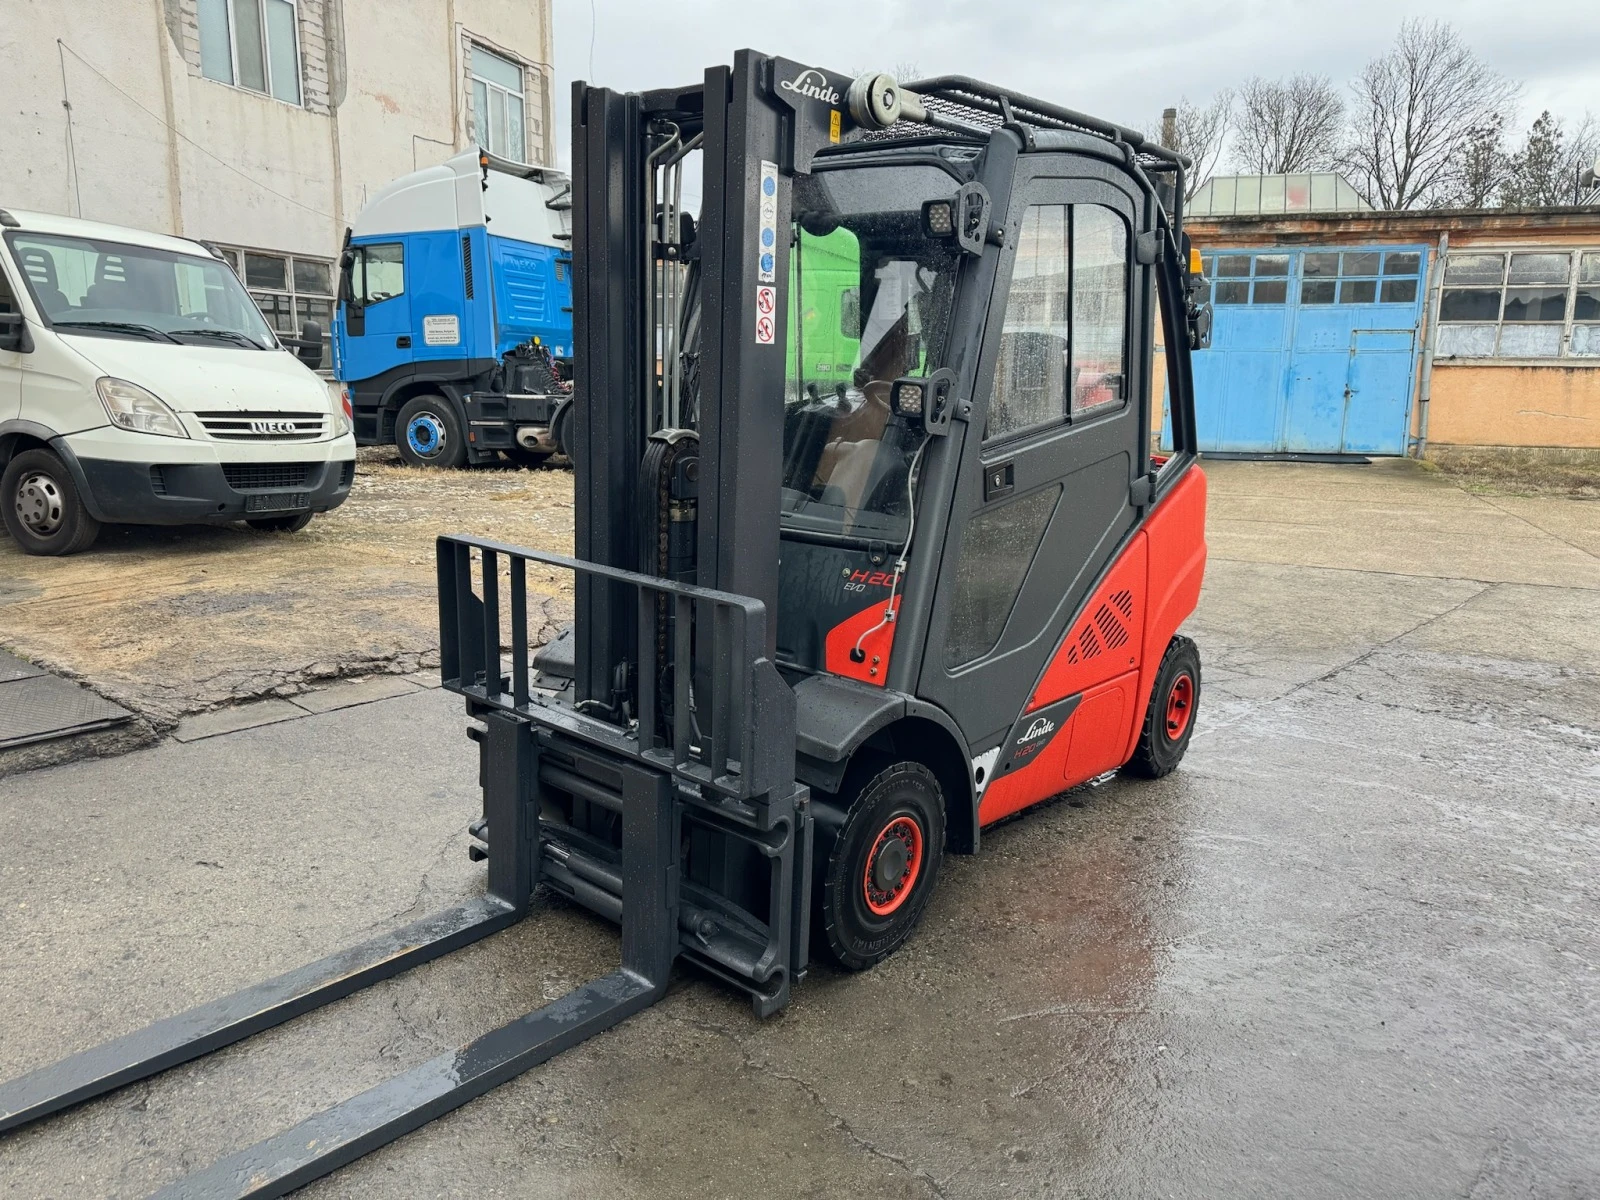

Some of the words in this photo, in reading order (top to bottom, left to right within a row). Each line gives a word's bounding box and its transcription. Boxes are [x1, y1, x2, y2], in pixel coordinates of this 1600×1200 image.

[781, 69, 839, 105] Linde
[250, 421, 296, 433] IVECO
[843, 582, 866, 592] EVO
[1017, 718, 1054, 744] Linde
[1013, 742, 1037, 759] H20
